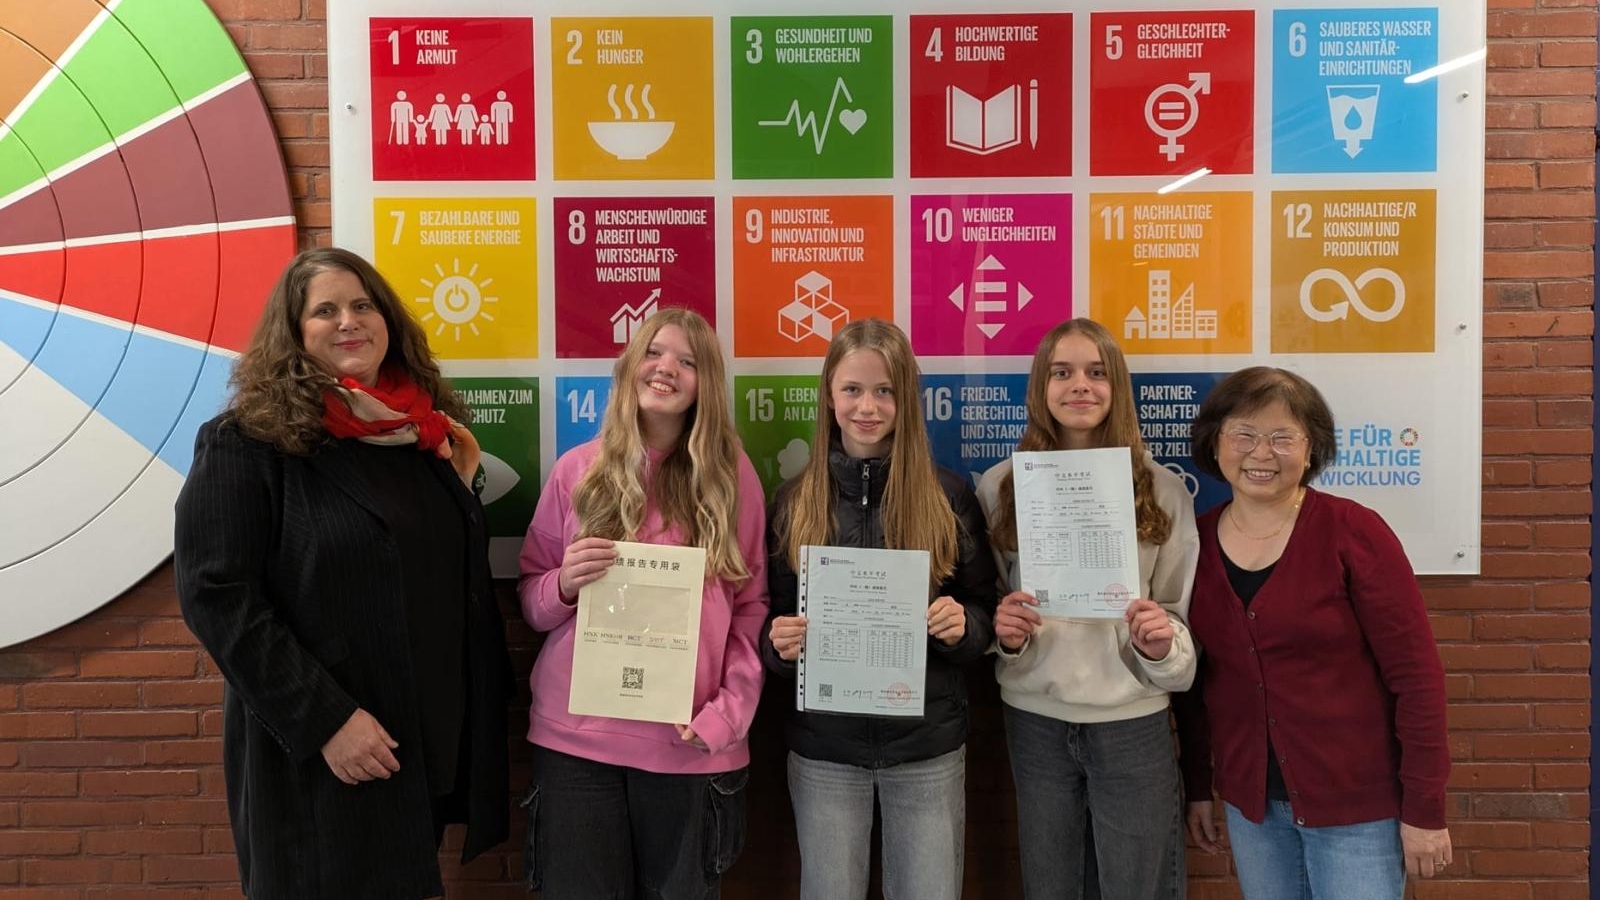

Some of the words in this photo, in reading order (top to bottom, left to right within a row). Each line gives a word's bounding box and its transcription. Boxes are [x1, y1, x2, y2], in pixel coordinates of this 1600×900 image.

[416, 29, 449, 46] KEINE
[596, 29, 623, 46] KEIN
[775, 28, 846, 44] GESUNDHEIT
[848, 28, 873, 44] UND
[955, 26, 1039, 43] HOCHWERTIGE
[1136, 22, 1231, 41] GESCHLECHTER-
[1319, 21, 1380, 38] SAUBERES
[1382, 20, 1432, 37] WASSER
[387, 29, 400, 65] 1
[566, 29, 583, 65] 2
[746, 28, 763, 65] 3
[924, 27, 943, 63] 4
[1105, 25, 1123, 61] 5
[1288, 21, 1307, 58] 6
[1319, 39, 1344, 57] UND
[1345, 36, 1400, 57] SANITÄR-
[416, 49, 458, 65] ARMUT
[597, 48, 644, 65] HUNGER
[775, 47, 861, 64] WOHLERGEHEN
[955, 45, 1006, 61] BILDUNG
[1137, 42, 1203, 60] GLEICHHEIT
[1319, 59, 1412, 77] EINRICHTUNGEN
[419, 210, 492, 227] BEZAHLBARE
[494, 210, 520, 225] UND
[594, 207, 707, 226] MENSCHENWÜRDIGE
[771, 208, 834, 227] INDUSTRIE,
[962, 207, 1014, 223] WENIGER
[1133, 204, 1213, 221] NACHHALTIGE
[1323, 201, 1418, 220] NACHHALTIGE/R
[389, 210, 405, 245] 7
[568, 210, 586, 245] 8
[745, 208, 763, 245] 9
[921, 207, 953, 243] 10
[1100, 206, 1125, 241] 11
[1283, 203, 1313, 239] 12
[1323, 221, 1373, 239] KONSUM
[1375, 220, 1400, 237] UND
[419, 229, 473, 246] SAUBERE
[474, 229, 521, 246] ENERGIE
[595, 229, 633, 245] ARBEIT
[635, 228, 660, 245] UND
[771, 227, 838, 244] INNOVATION
[840, 227, 865, 244] UND
[962, 225, 1057, 242] UNGLEICHHEITEN
[1133, 221, 1176, 240] STÄDTE
[1178, 224, 1204, 240] UND
[595, 248, 678, 264] WIRTSCHAFTS-
[771, 246, 865, 262] INFRASTRUKTUR
[1133, 242, 1200, 260] GEMEINDEN
[1323, 240, 1400, 258] PRODUKTION
[596, 267, 660, 283] WACHSTUM
[508, 389, 533, 404] ZUM
[783, 387, 818, 402] LEBEN
[960, 386, 1011, 402] FRIEDEN,
[1140, 385, 1197, 401] PARTNER-
[567, 389, 597, 424] 14
[745, 388, 775, 422] 15
[923, 386, 953, 421] 16
[1140, 404, 1201, 420] SCHAFTEN
[783, 406, 800, 421] AN
[961, 424, 986, 439] UND
[1140, 423, 1164, 438] ZUR
[1349, 424, 1392, 447] FÜR
